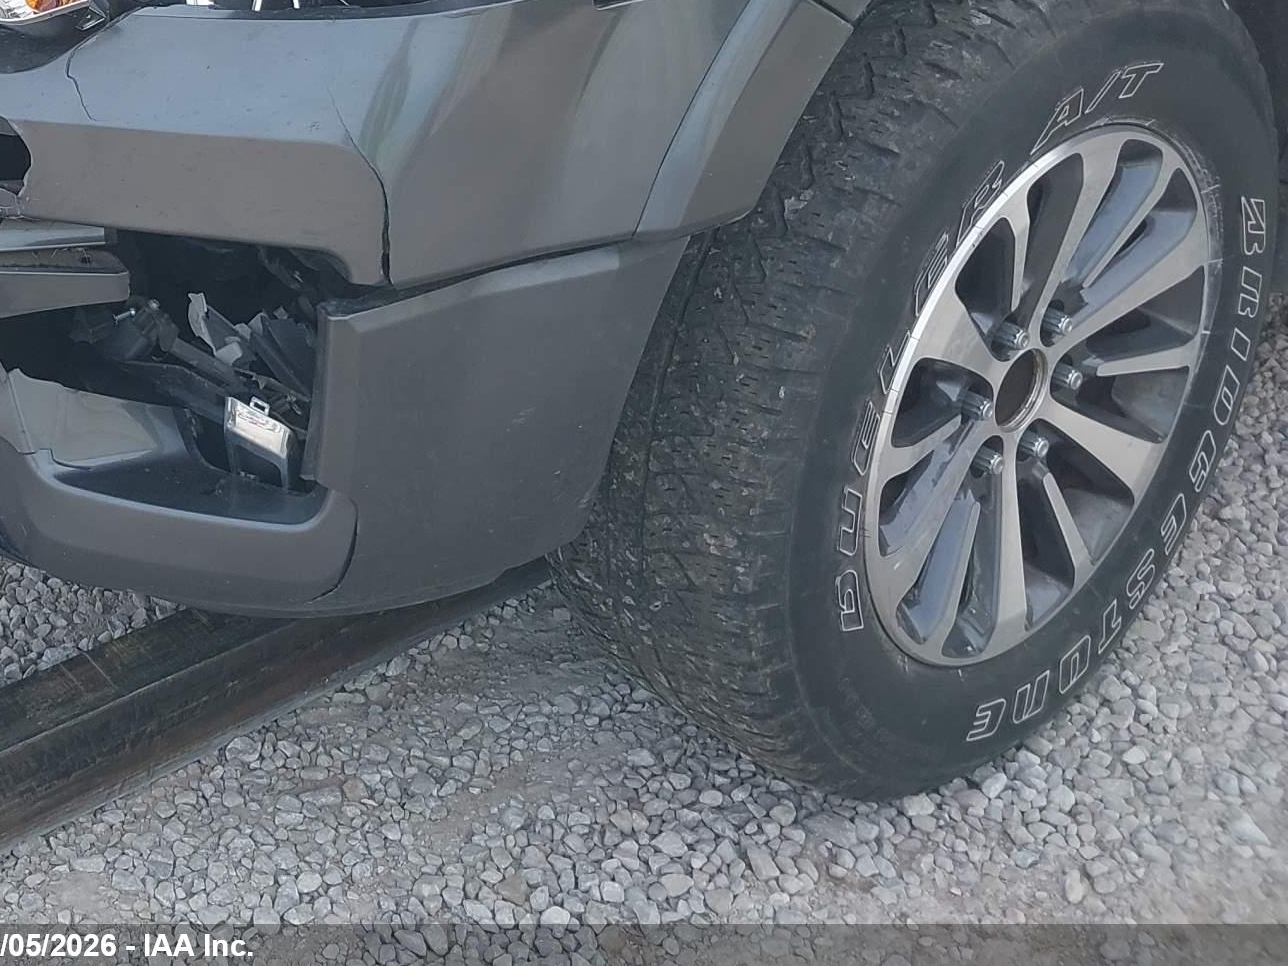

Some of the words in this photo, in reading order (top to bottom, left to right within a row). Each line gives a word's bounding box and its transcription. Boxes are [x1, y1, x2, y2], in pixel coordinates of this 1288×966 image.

[833, 159, 1007, 633] DUELER
[1031, 60, 1165, 156] A/T
[966, 194, 1267, 743] BRIDGESTONE
